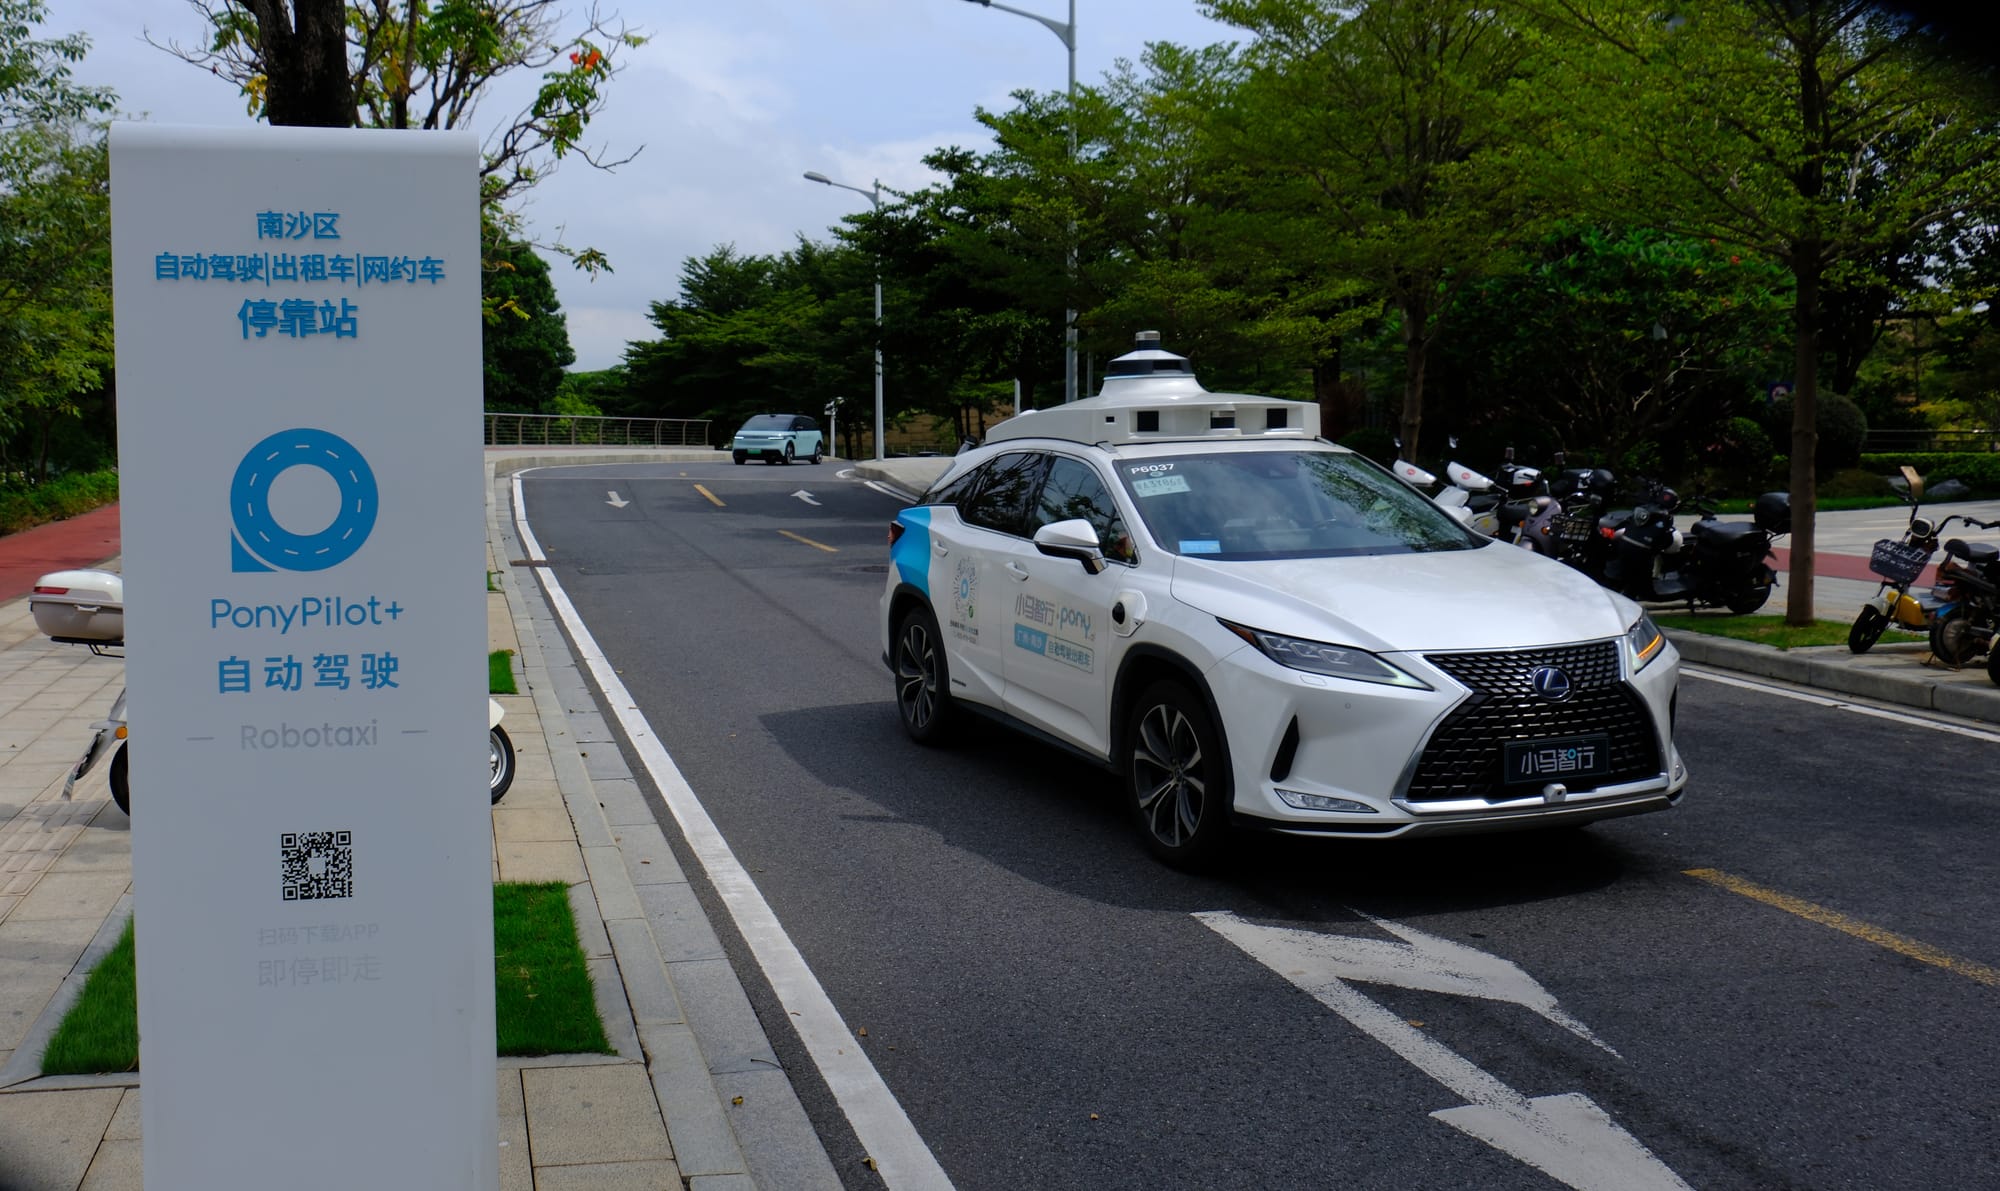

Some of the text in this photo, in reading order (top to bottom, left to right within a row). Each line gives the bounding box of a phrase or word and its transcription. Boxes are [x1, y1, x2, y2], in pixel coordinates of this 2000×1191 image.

[256, 211, 340, 240] 南沙区
[237, 298, 359, 340] 停靠站
[1131, 463, 1174, 474] P6037
[210, 596, 404, 634] PonyPilot+
[1015, 593, 1055, 626] 小马智行
[217, 651, 401, 694] 自动驾驶
[240, 718, 379, 750] Robotaxi
[1521, 746, 1595, 775] 小马智行
[257, 953, 384, 988] 即停即走
